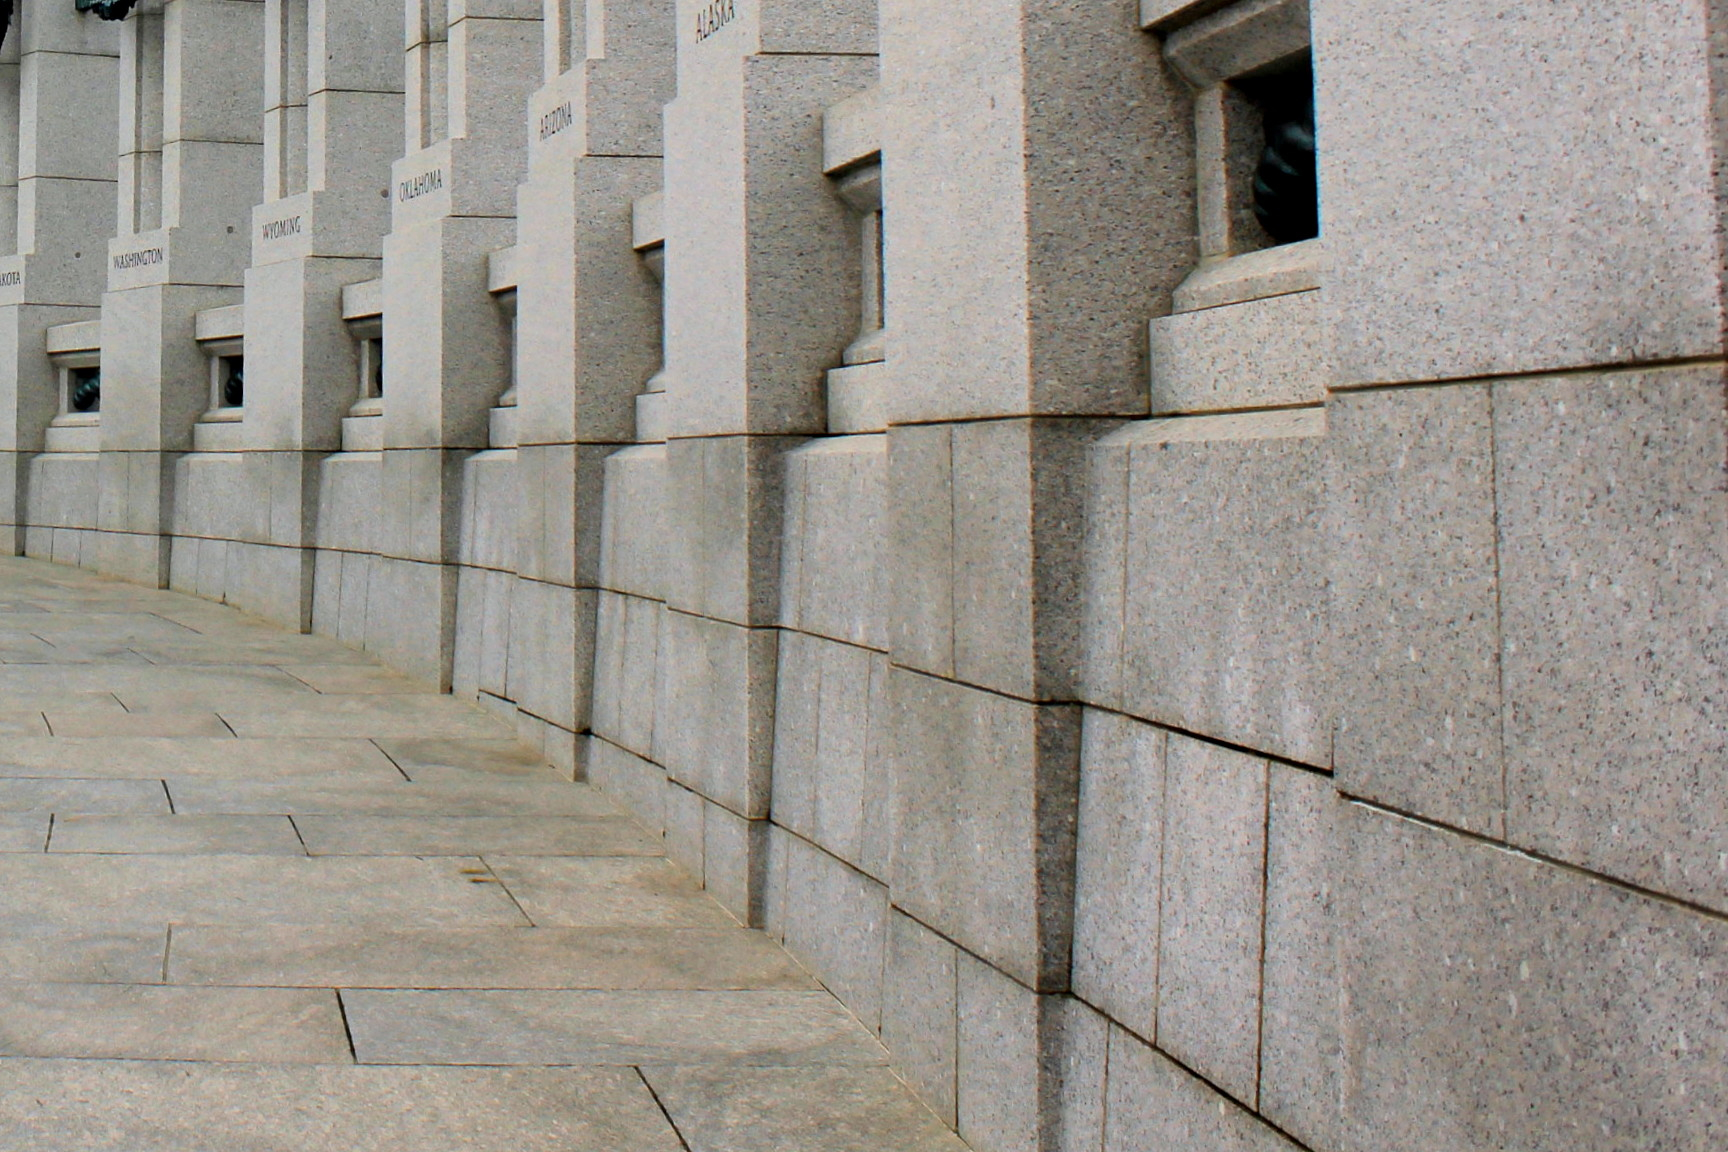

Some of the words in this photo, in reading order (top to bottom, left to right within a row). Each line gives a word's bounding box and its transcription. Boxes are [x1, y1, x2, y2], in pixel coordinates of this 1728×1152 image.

[538, 100, 573, 142] ARIZONA
[398, 168, 443, 204] OKLAHOMA
[261, 215, 302, 241] WYOMING
[112, 247, 165, 270] WASHINGTON
